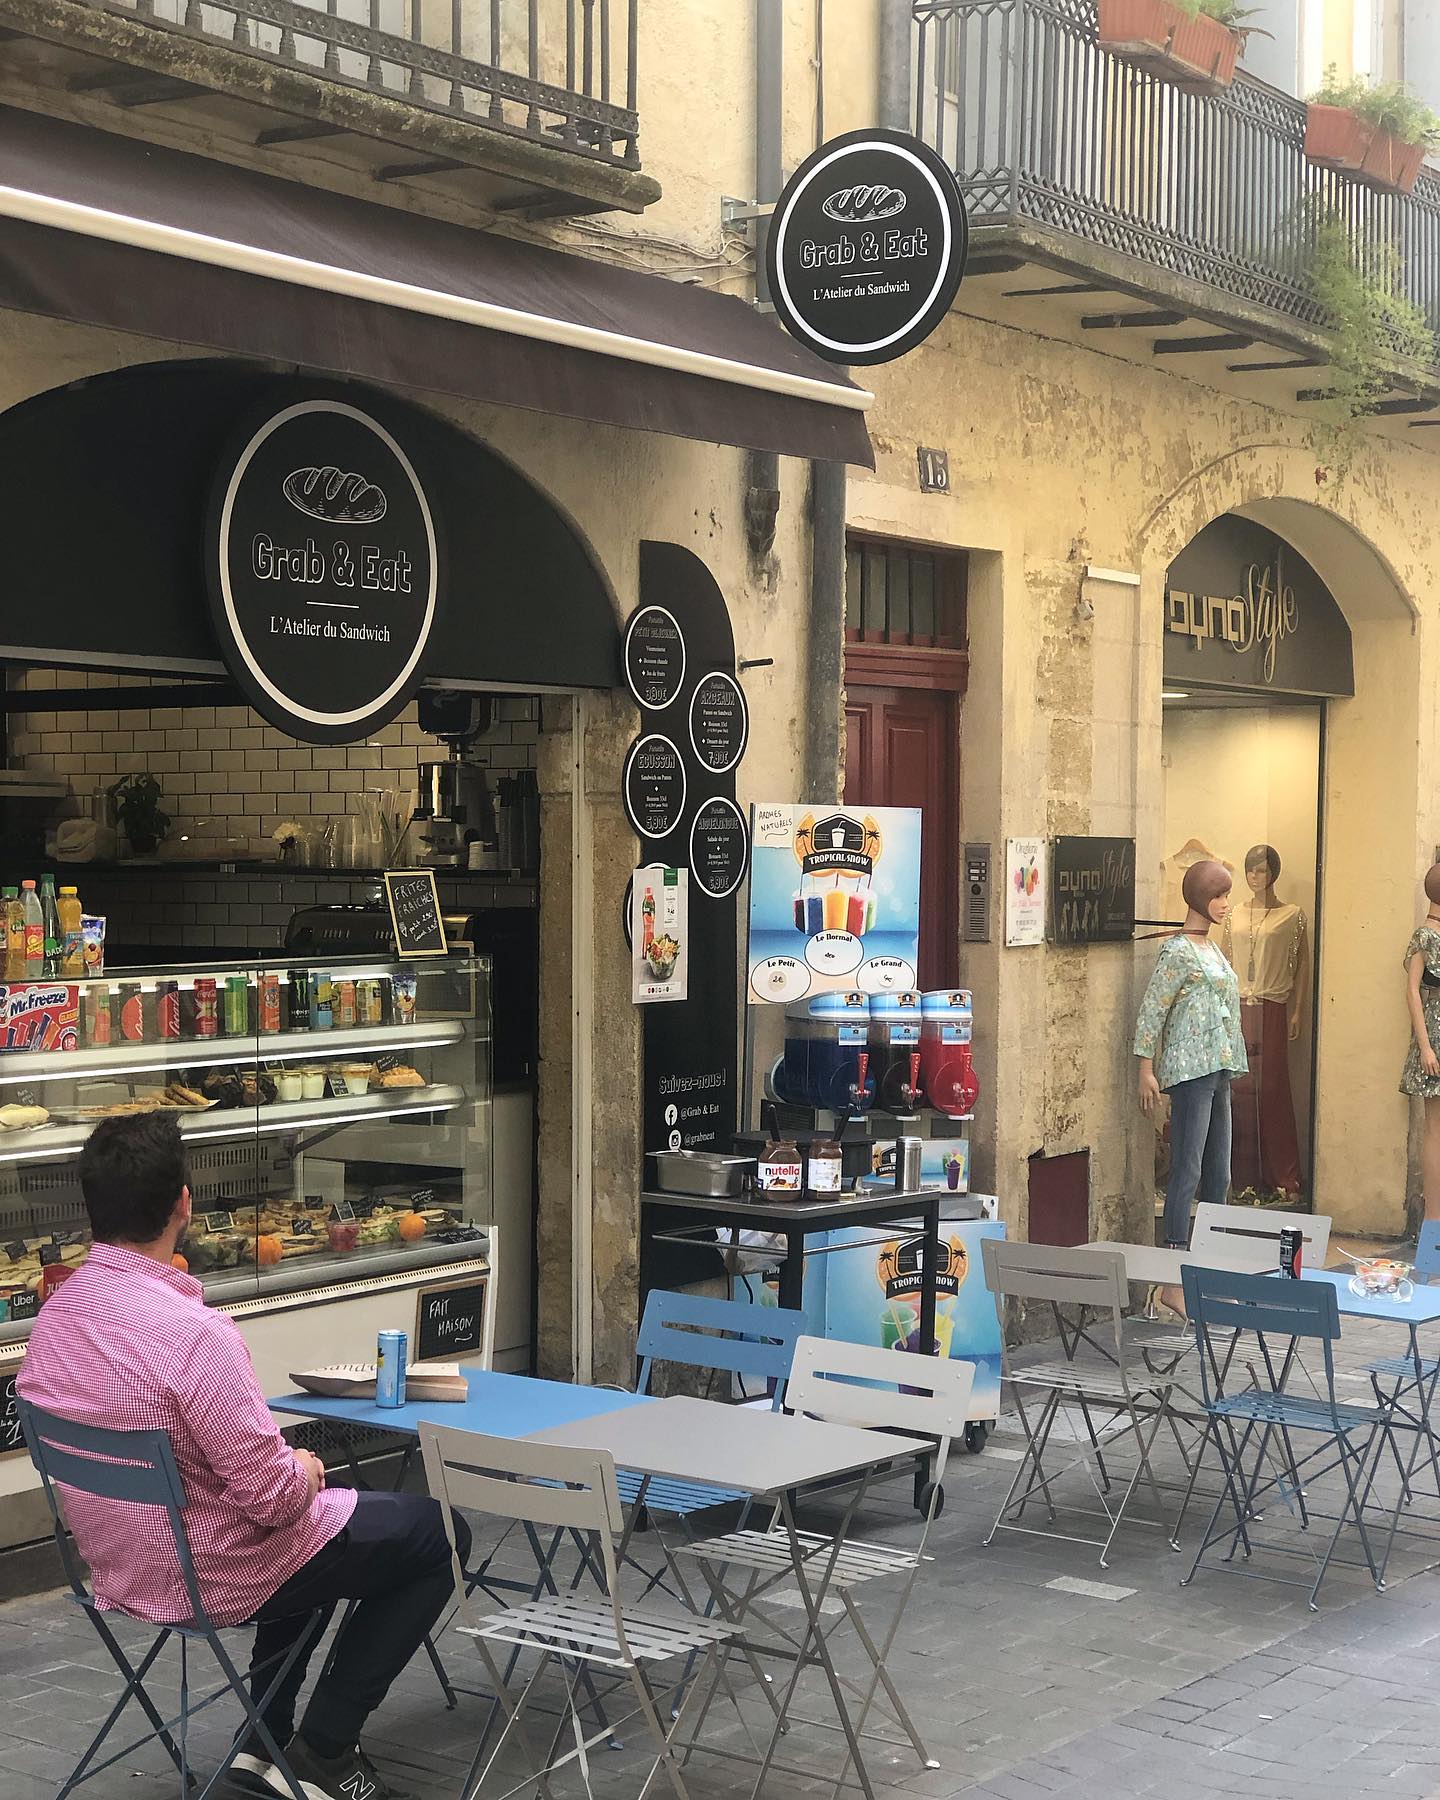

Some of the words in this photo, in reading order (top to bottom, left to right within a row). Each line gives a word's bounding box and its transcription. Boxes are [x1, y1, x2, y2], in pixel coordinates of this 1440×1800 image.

[800, 235, 855, 269] Grab
[860, 231, 879, 262] &
[884, 227, 928, 260] Eat
[813, 287, 853, 301] L'Atelier
[854, 285, 866, 297] du
[867, 280, 910, 296] Sandwich
[252, 533, 325, 583] Grab
[331, 540, 355, 587] &
[360, 545, 412, 593] Eat
[269, 616, 321, 636] L'Atelier
[323, 620, 337, 638] du
[339, 621, 391, 642] Sandwich
[638, 753, 676, 769] ECUSSON
[815, 935, 825, 943] Le
[767, 960, 777, 968] Le
[870, 961, 880, 969] Le
[765, 1165, 800, 1176] nutella
[13, 1295, 35, 1307] Uber
